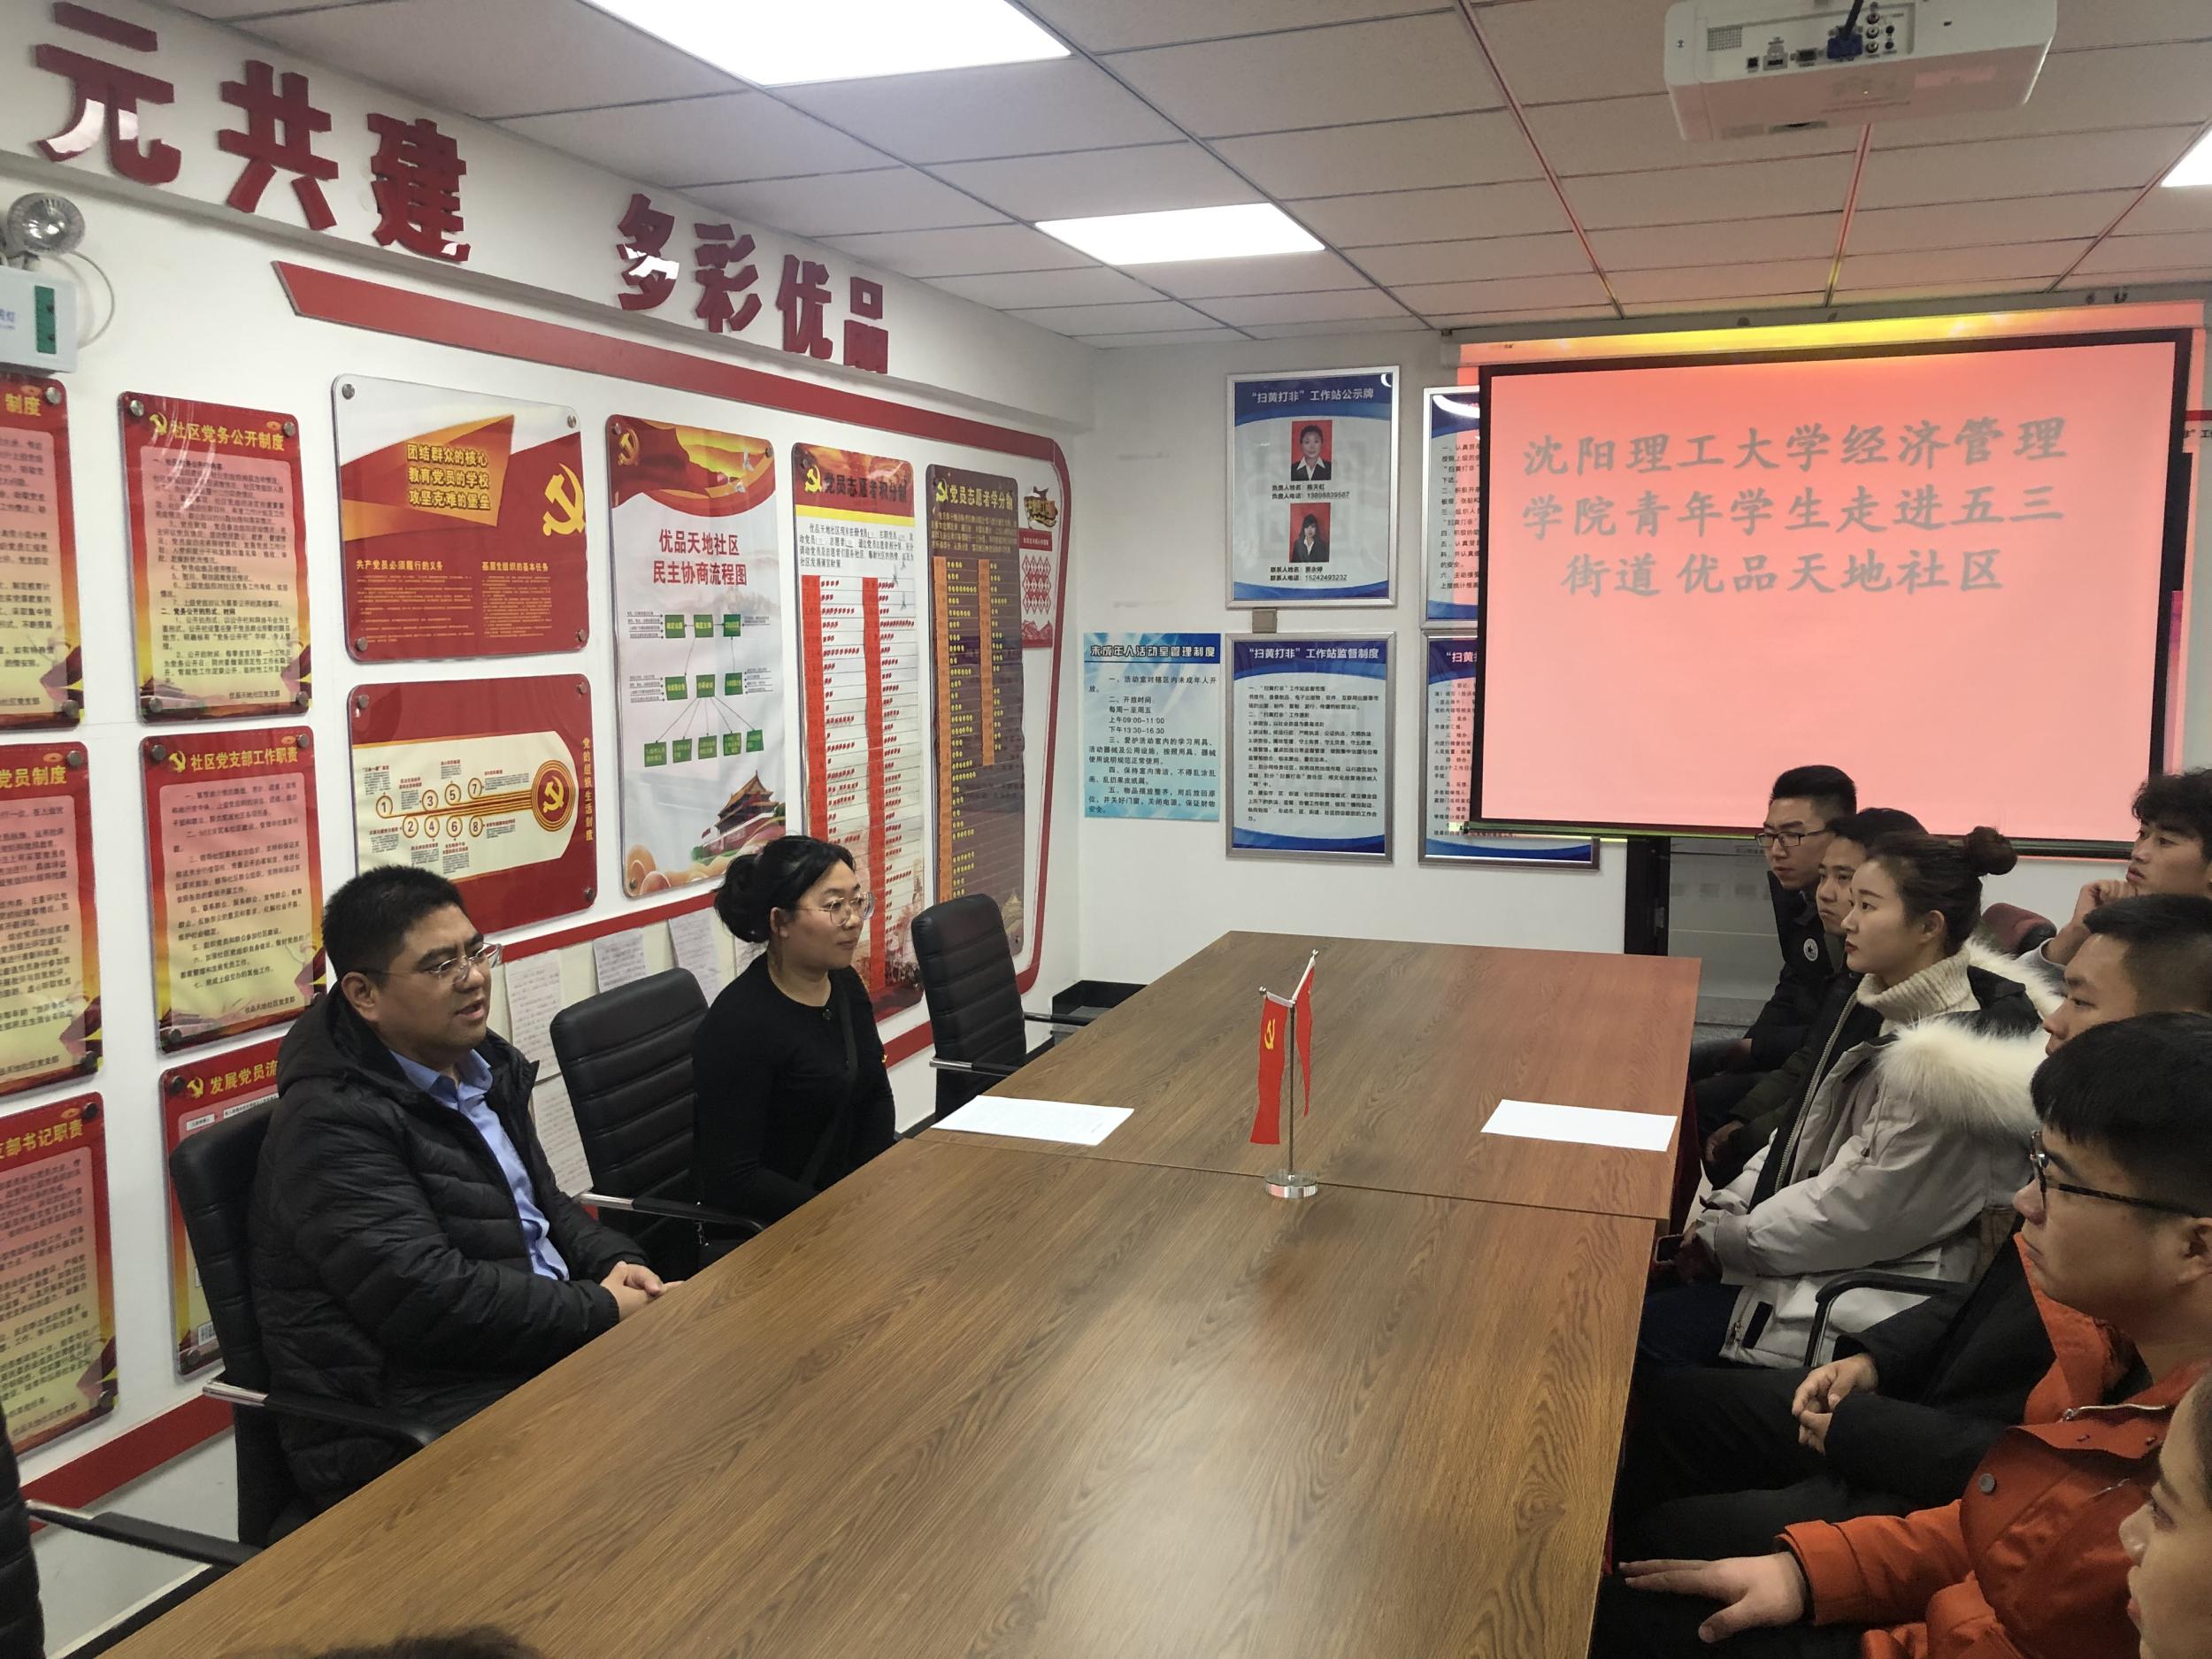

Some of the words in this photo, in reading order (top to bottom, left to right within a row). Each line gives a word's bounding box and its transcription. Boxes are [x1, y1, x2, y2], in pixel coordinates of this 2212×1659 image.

[34, 2, 471, 264] 元共建
[617, 193, 888, 375] 多彩优品
[5, 393, 42, 417] 制度
[1252, 388, 1374, 403] “扫黄打非”工作站公示牌
[174, 421, 285, 451] 社区党务公开制度
[1522, 417, 2069, 477] 沈阳理工大学经济管理
[406, 444, 488, 466] 团结群众的核心
[408, 465, 490, 488] 教育党员的学校
[409, 488, 491, 511] 攻坚克难的堡垒
[949, 484, 1013, 511] 党员志愿者学分制
[1521, 483, 2065, 541] 学院青年学生走进五三
[659, 528, 740, 556] 优品天地社区
[356, 559, 443, 572] 共产党员必须履行的义务
[653, 560, 747, 586] 民主协商流程图
[1560, 549, 2005, 599] 街道优品天地社区
[1090, 645, 1216, 657] 未成年人活动室管理制度
[1248, 648, 1379, 659] “扫黄打非”工作站监督制度
[190, 747, 298, 772] 社区党支部工作职责
[0, 765, 67, 788] 党员制度
[449, 789, 456, 800] 5
[472, 783, 477, 794] 7
[582, 738, 594, 841] 党的组织生活制度
[381, 802, 387, 812] 1
[427, 795, 434, 807] 3
[408, 821, 413, 831] 2
[429, 821, 434, 832] 4
[451, 821, 457, 832] 6
[472, 821, 478, 832] 8
